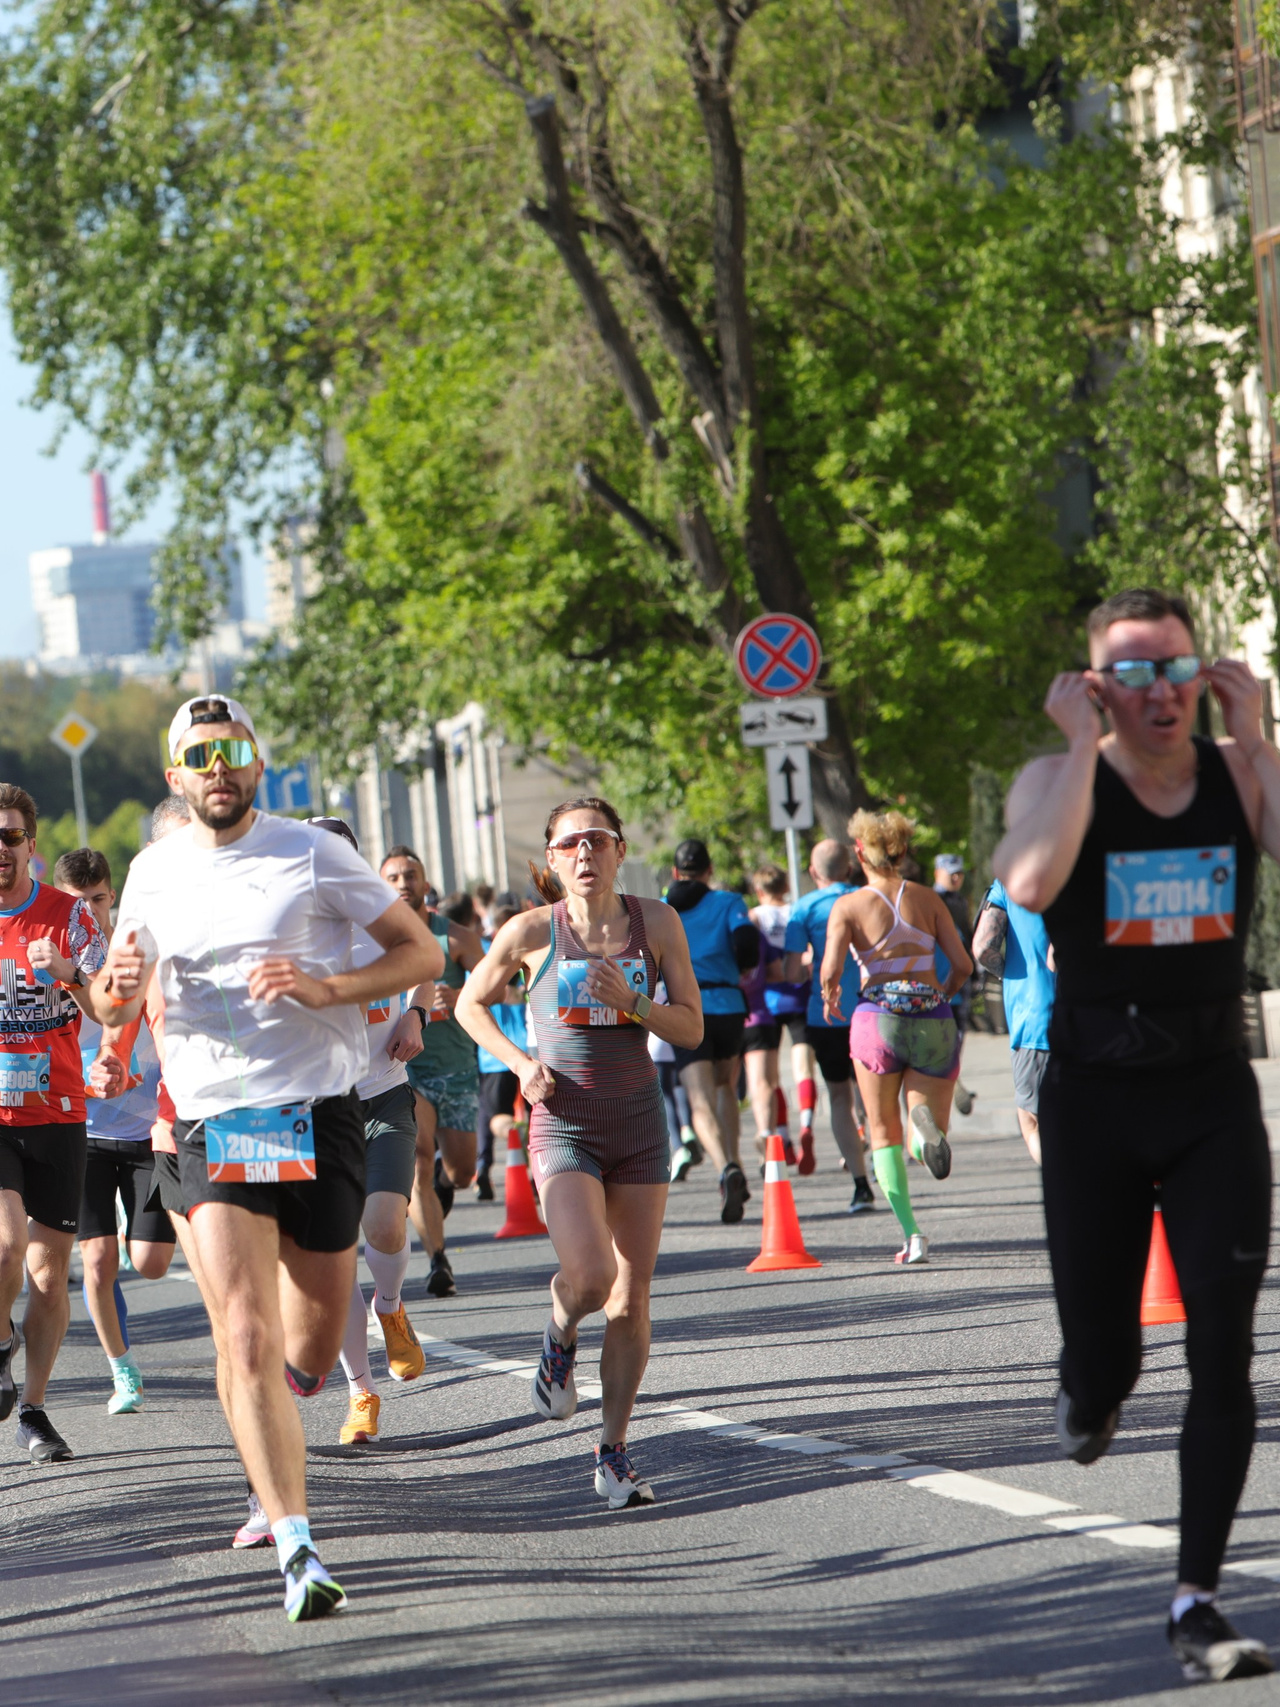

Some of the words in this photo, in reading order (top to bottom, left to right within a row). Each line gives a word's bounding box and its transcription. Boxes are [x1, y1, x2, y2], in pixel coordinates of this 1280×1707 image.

[1133, 877, 1211, 916] 27014
[1151, 916, 1194, 946] 5KM
[635, 973, 642, 982] A
[589, 1007, 618, 1026] 5KM
[41, 1075, 48, 1083] A
[0, 1091, 25, 1107] 5KM
[295, 1121, 305, 1133] A
[244, 1161, 280, 1183] 5KM
